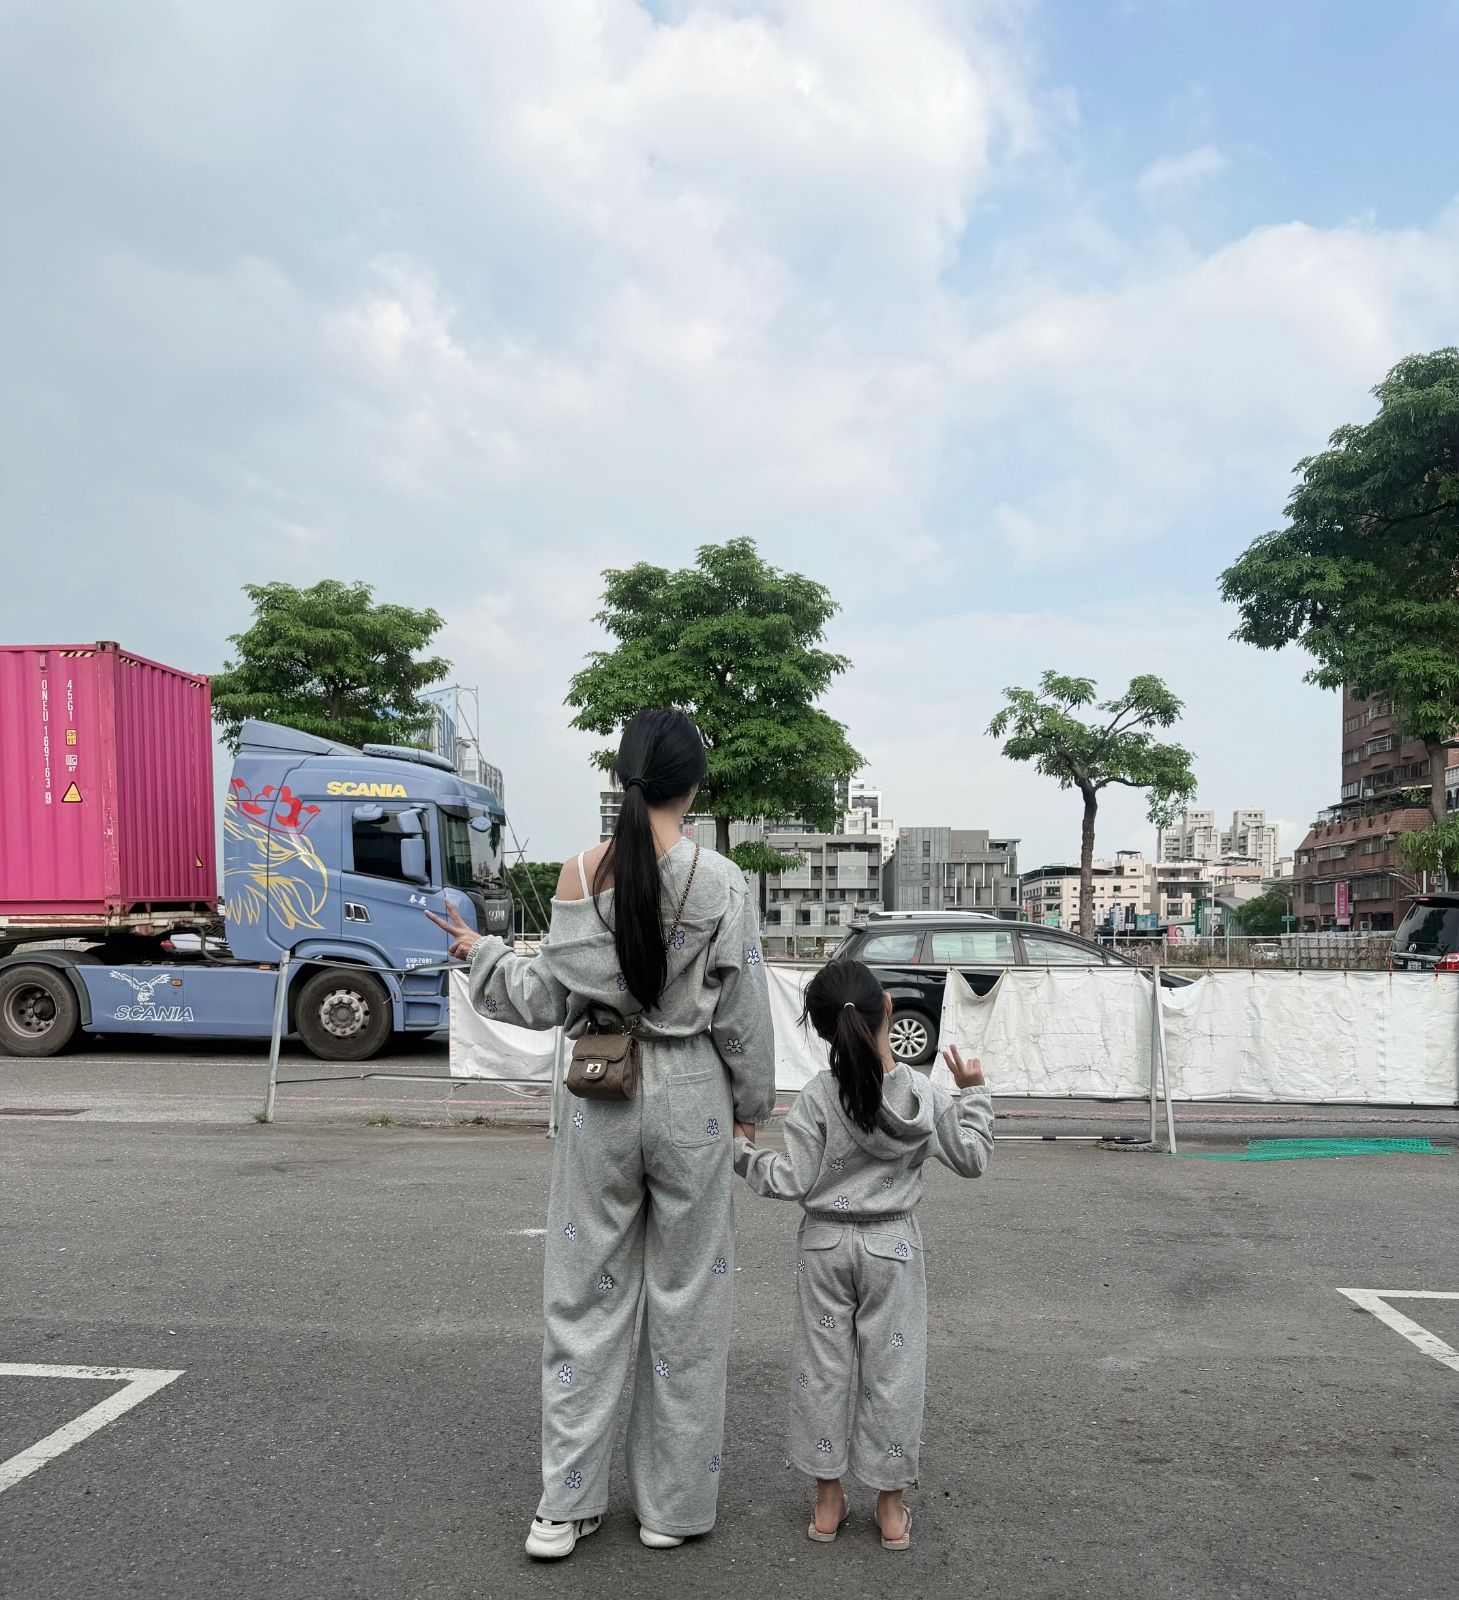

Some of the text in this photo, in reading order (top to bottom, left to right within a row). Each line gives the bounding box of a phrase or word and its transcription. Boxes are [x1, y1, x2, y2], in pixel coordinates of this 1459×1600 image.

[41, 679, 49, 721] ONEU
[43, 725, 51, 788] 169163
[326, 781, 408, 798] SCANIA
[114, 1005, 195, 1022] SCANIA
